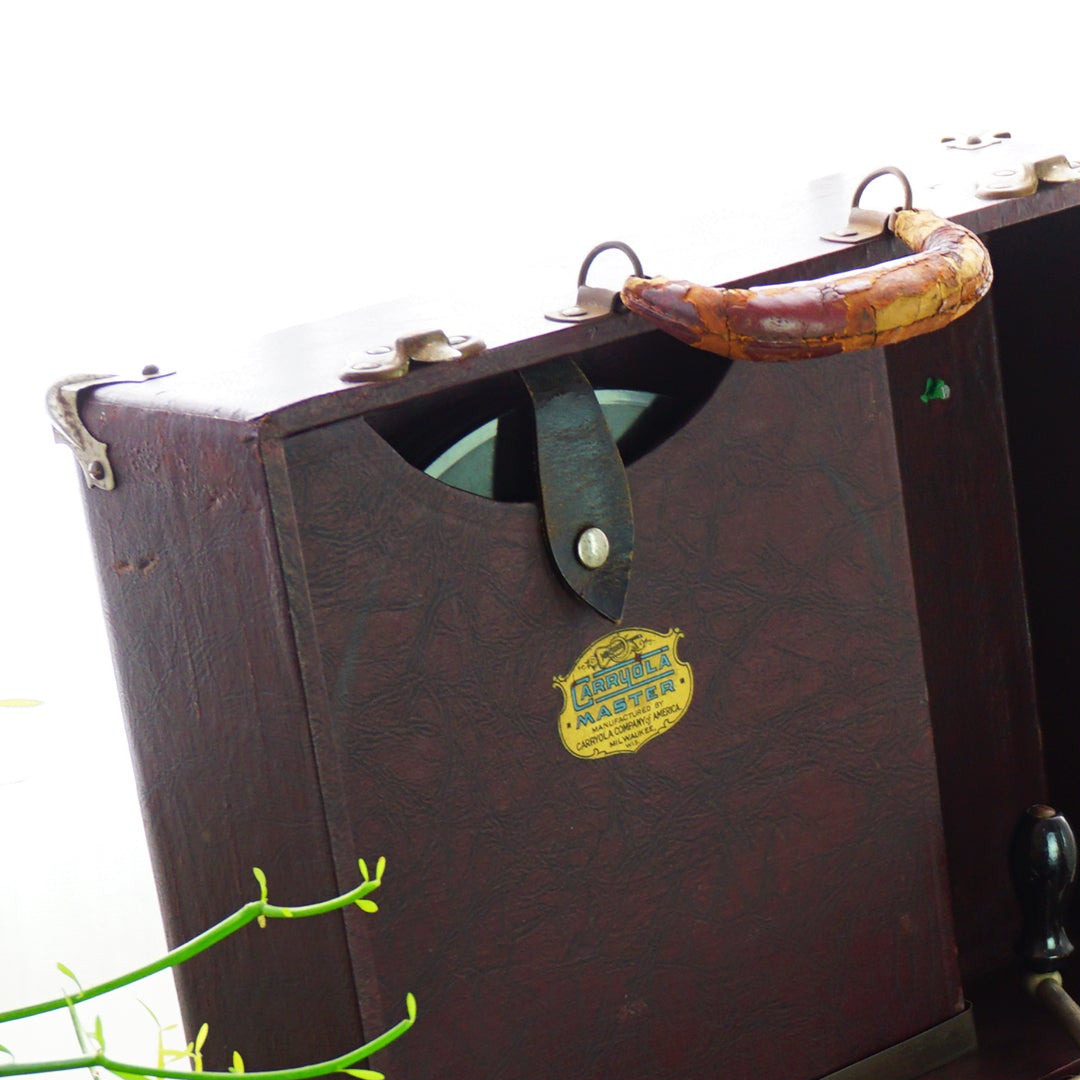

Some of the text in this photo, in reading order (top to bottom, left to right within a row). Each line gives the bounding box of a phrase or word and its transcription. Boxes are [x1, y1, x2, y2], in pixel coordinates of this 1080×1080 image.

[571, 652, 672, 712] CARRYOLA
[575, 679, 676, 730] MASTER
[592, 699, 664, 733] MANUFACTURED BY
[576, 728, 614, 751] CARRYOLA
[614, 717, 646, 737] COMPANY
